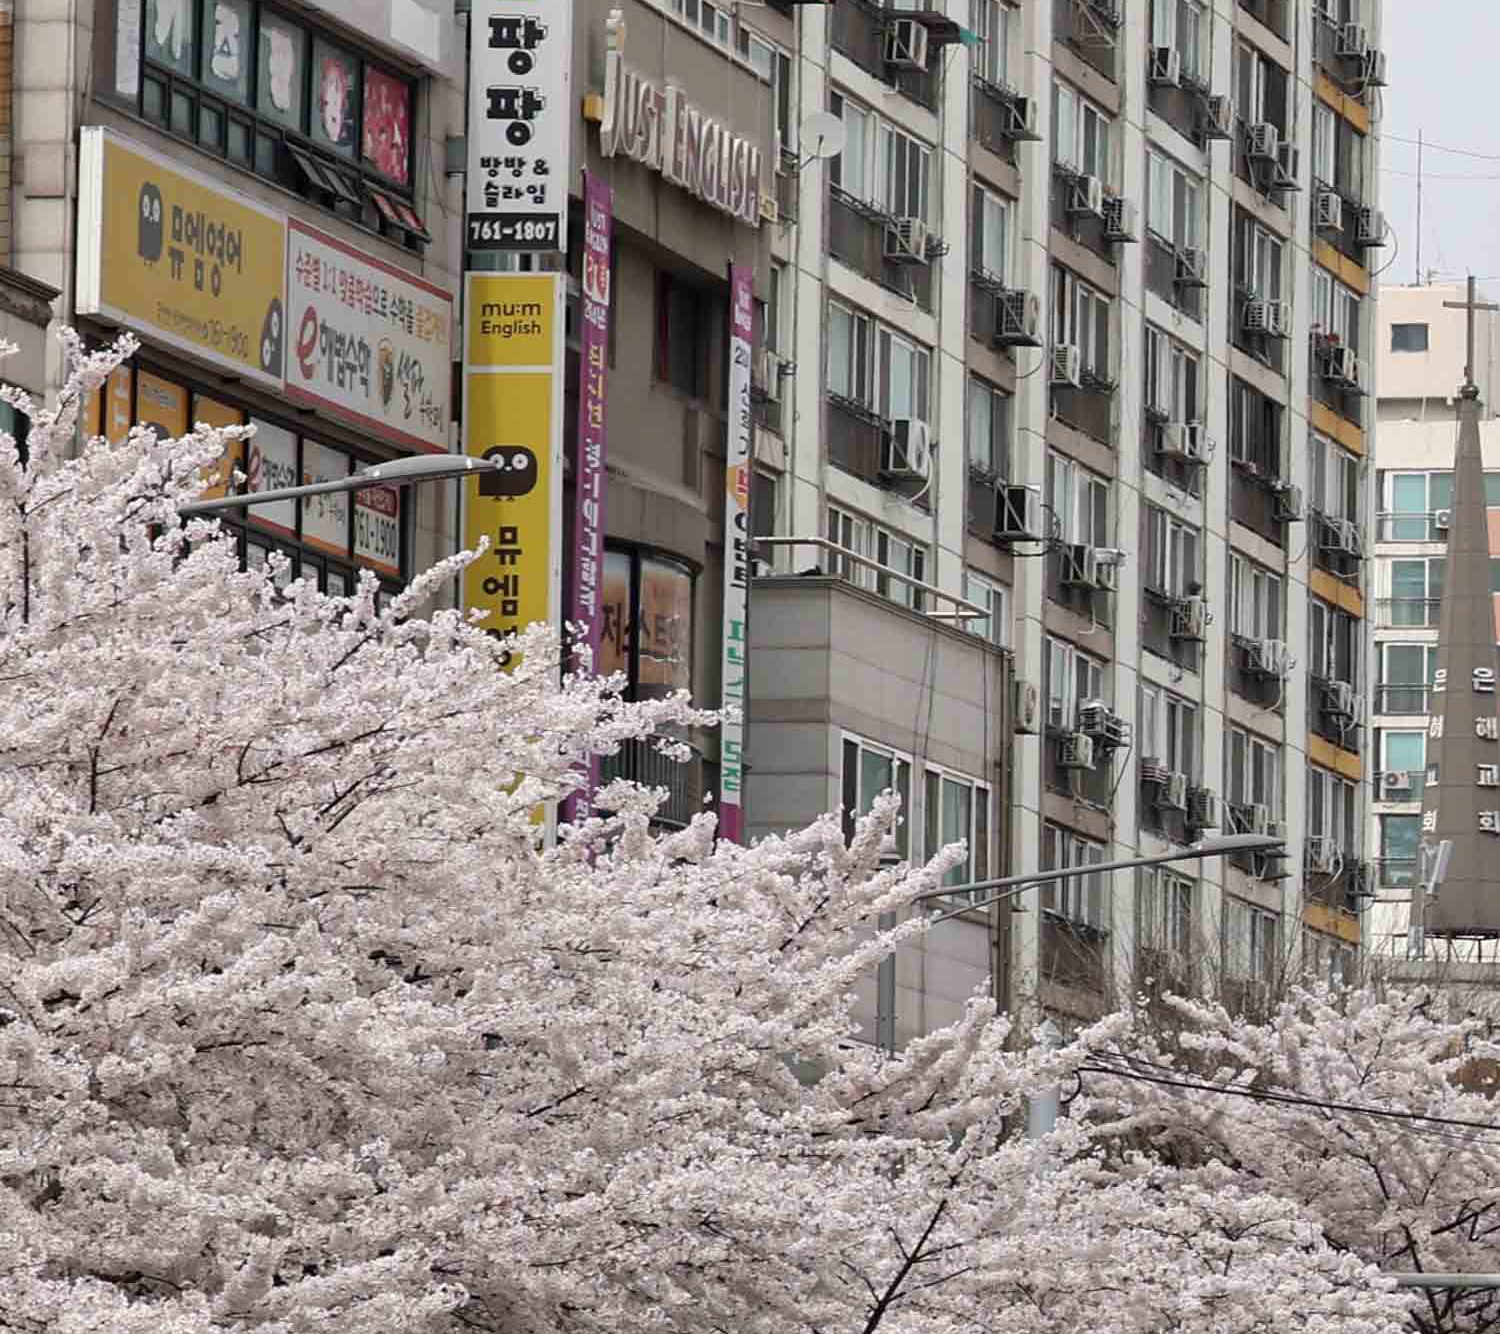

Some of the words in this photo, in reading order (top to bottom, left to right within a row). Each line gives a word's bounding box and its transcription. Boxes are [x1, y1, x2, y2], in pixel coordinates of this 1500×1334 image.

[481, 157, 526, 178] 방방
[470, 220, 556, 241] 761-1807
[481, 302, 542, 316] mu:m
[480, 319, 542, 339] English
